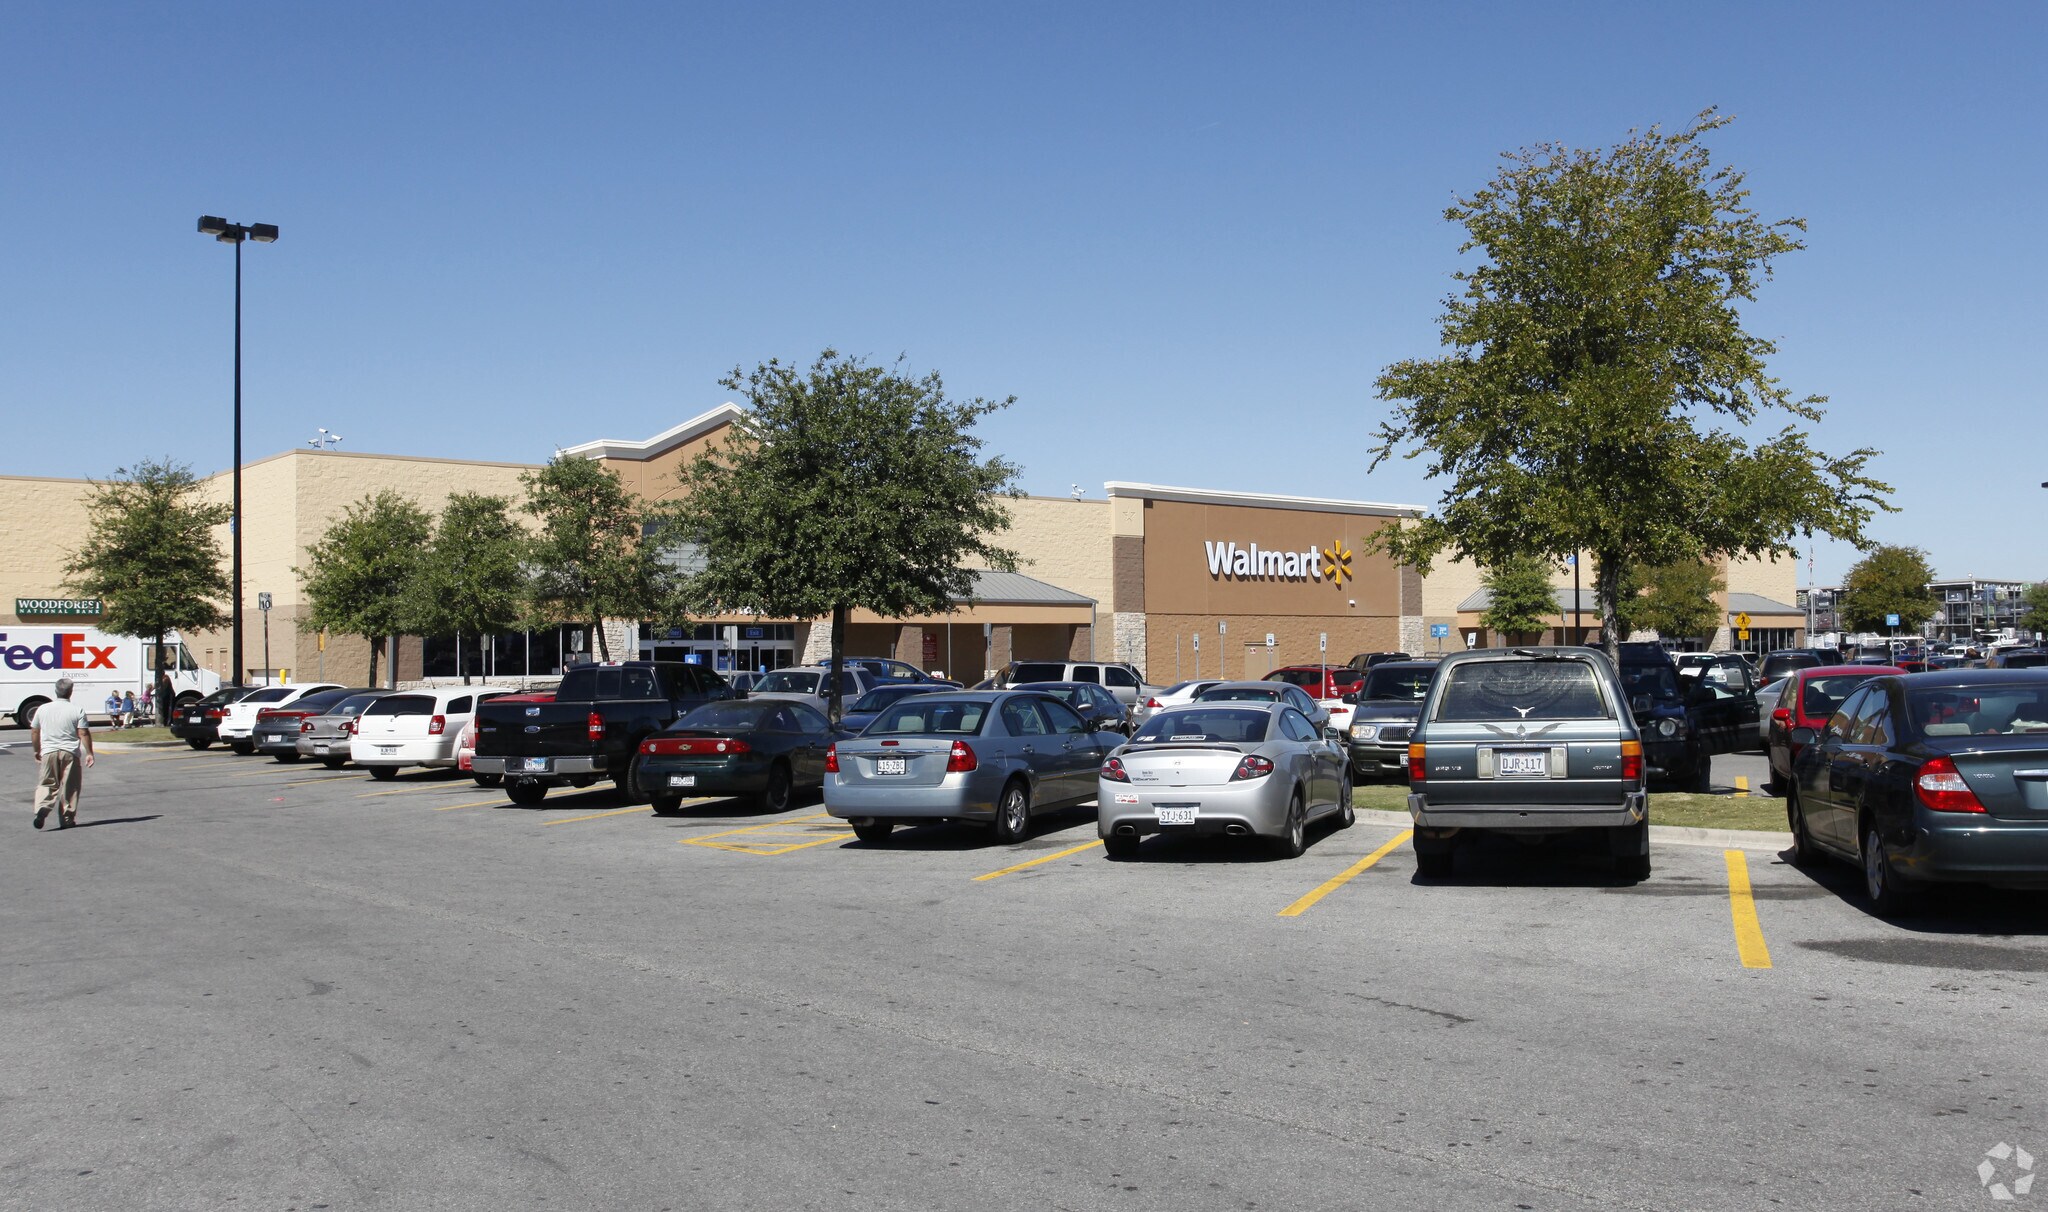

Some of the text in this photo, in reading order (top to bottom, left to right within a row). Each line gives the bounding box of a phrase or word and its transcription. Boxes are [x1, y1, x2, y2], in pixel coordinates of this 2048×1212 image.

[1205, 541, 1320, 577] Walmart
[18, 600, 102, 609] WOODFOREST
[261, 600, 271, 609] 10
[62, 671, 89, 679] Express
